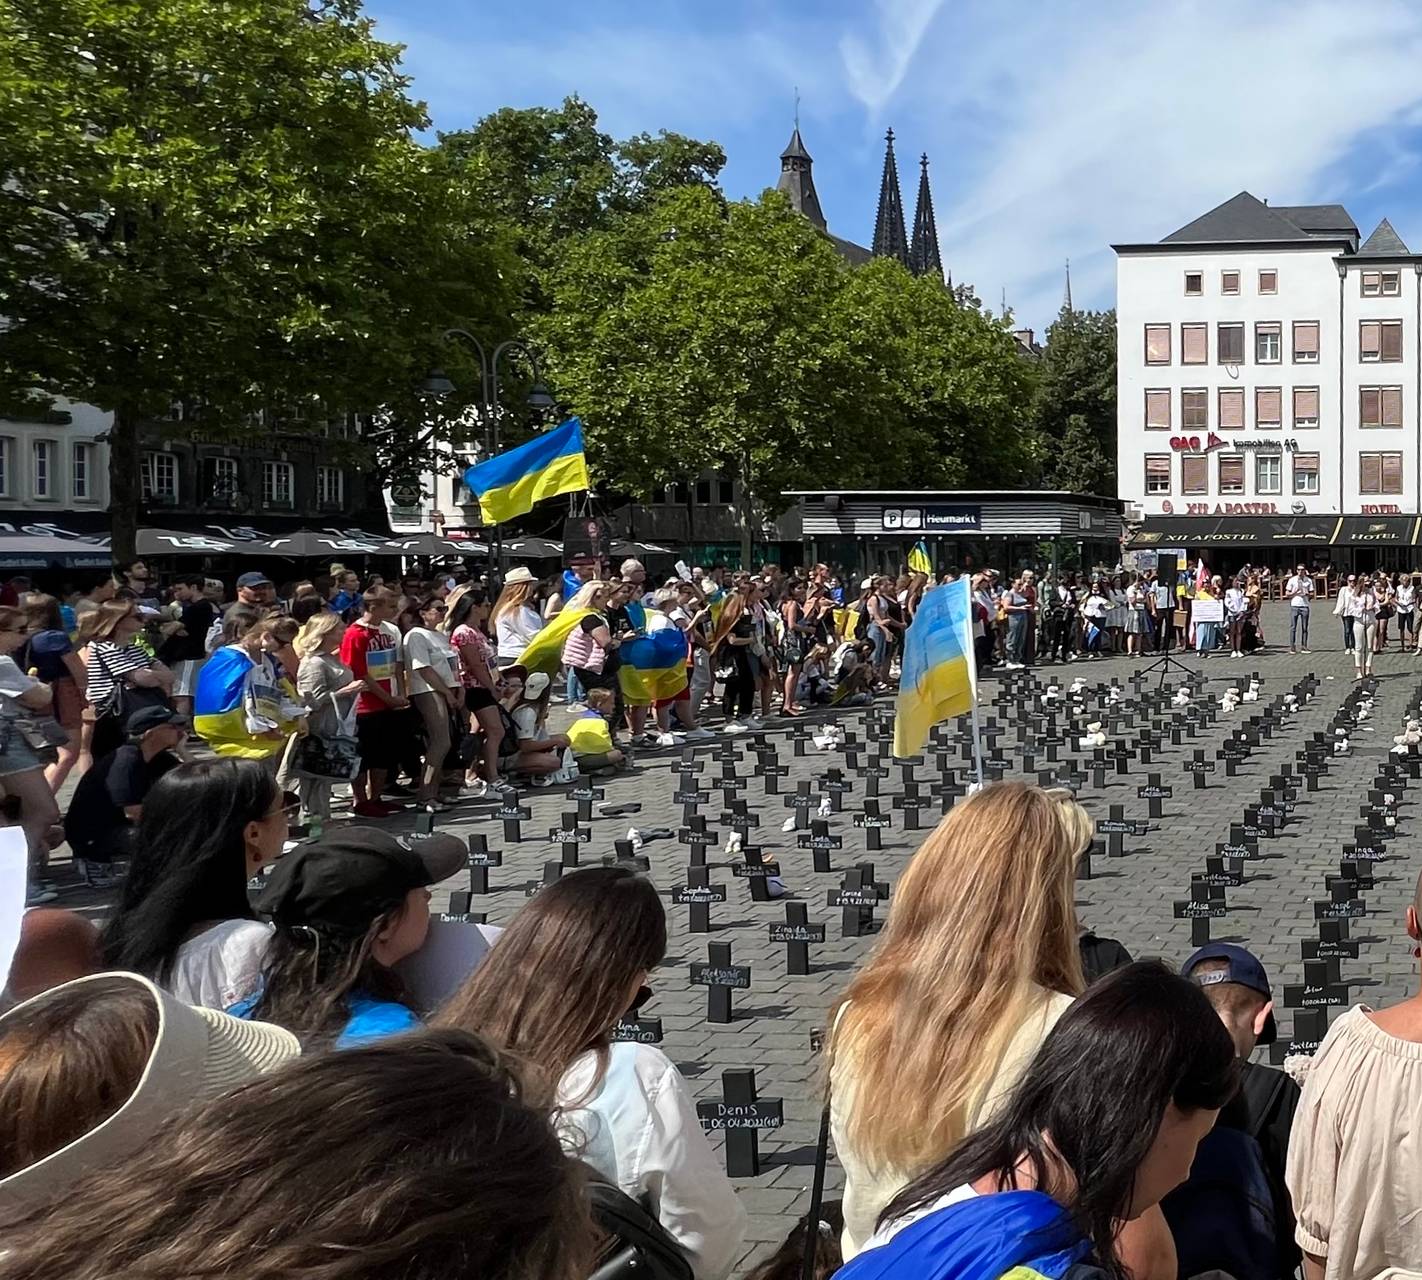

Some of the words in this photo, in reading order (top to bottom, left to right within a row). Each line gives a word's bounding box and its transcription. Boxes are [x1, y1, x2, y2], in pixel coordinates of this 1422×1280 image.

[1169, 436, 1201, 450] GAG
[1187, 503, 1209, 514] XII
[1214, 503, 1278, 514] APOSTEL
[1361, 504, 1401, 514] HOTEL
[926, 513, 976, 524] Heumarkt
[718, 1103, 758, 1117] Denis
